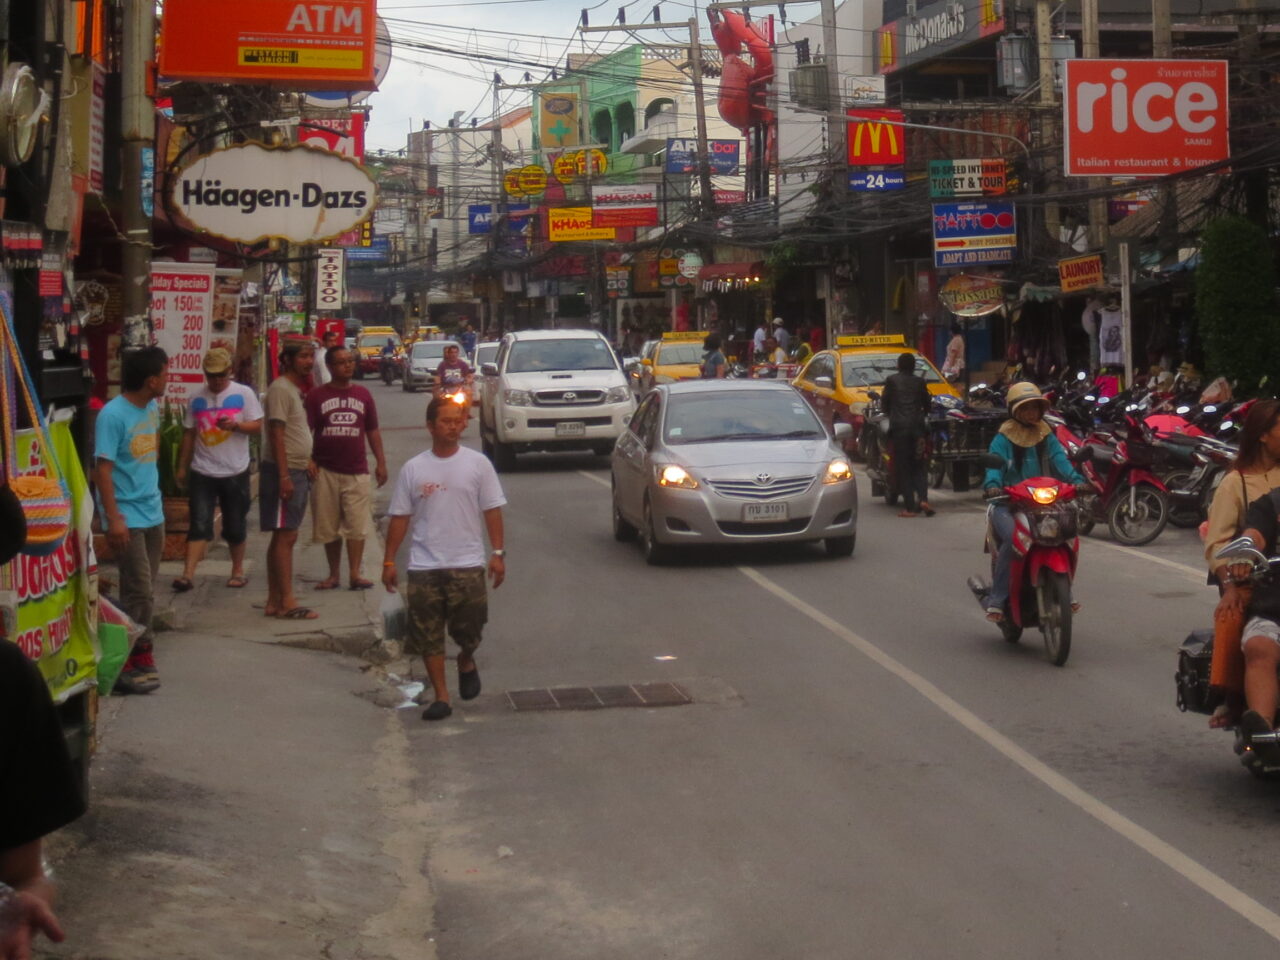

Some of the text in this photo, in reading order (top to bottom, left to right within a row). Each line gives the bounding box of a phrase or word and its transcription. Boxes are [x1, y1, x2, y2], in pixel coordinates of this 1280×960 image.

[286, 3, 363, 34] ATM
[1076, 67, 1219, 134] rice
[1184, 138, 1212, 146] SAMUI
[1077, 157, 1110, 167] Italian
[1114, 157, 1168, 167] restaurant
[1172, 158, 1181, 167] &
[866, 174, 885, 189] 24
[931, 176, 1003, 189] TICKET & TOUR
[182, 179, 367, 214] Häagen-Dazs
[934, 211, 1014, 231] TATTOO
[1059, 259, 1101, 281] LAUNDRY
[173, 278, 208, 290] Specials
[1067, 276, 1099, 288] EXPRESS
[174, 295, 193, 312] 150
[183, 315, 204, 331] 200
[182, 334, 202, 351] 300
[175, 353, 201, 370] 1000
